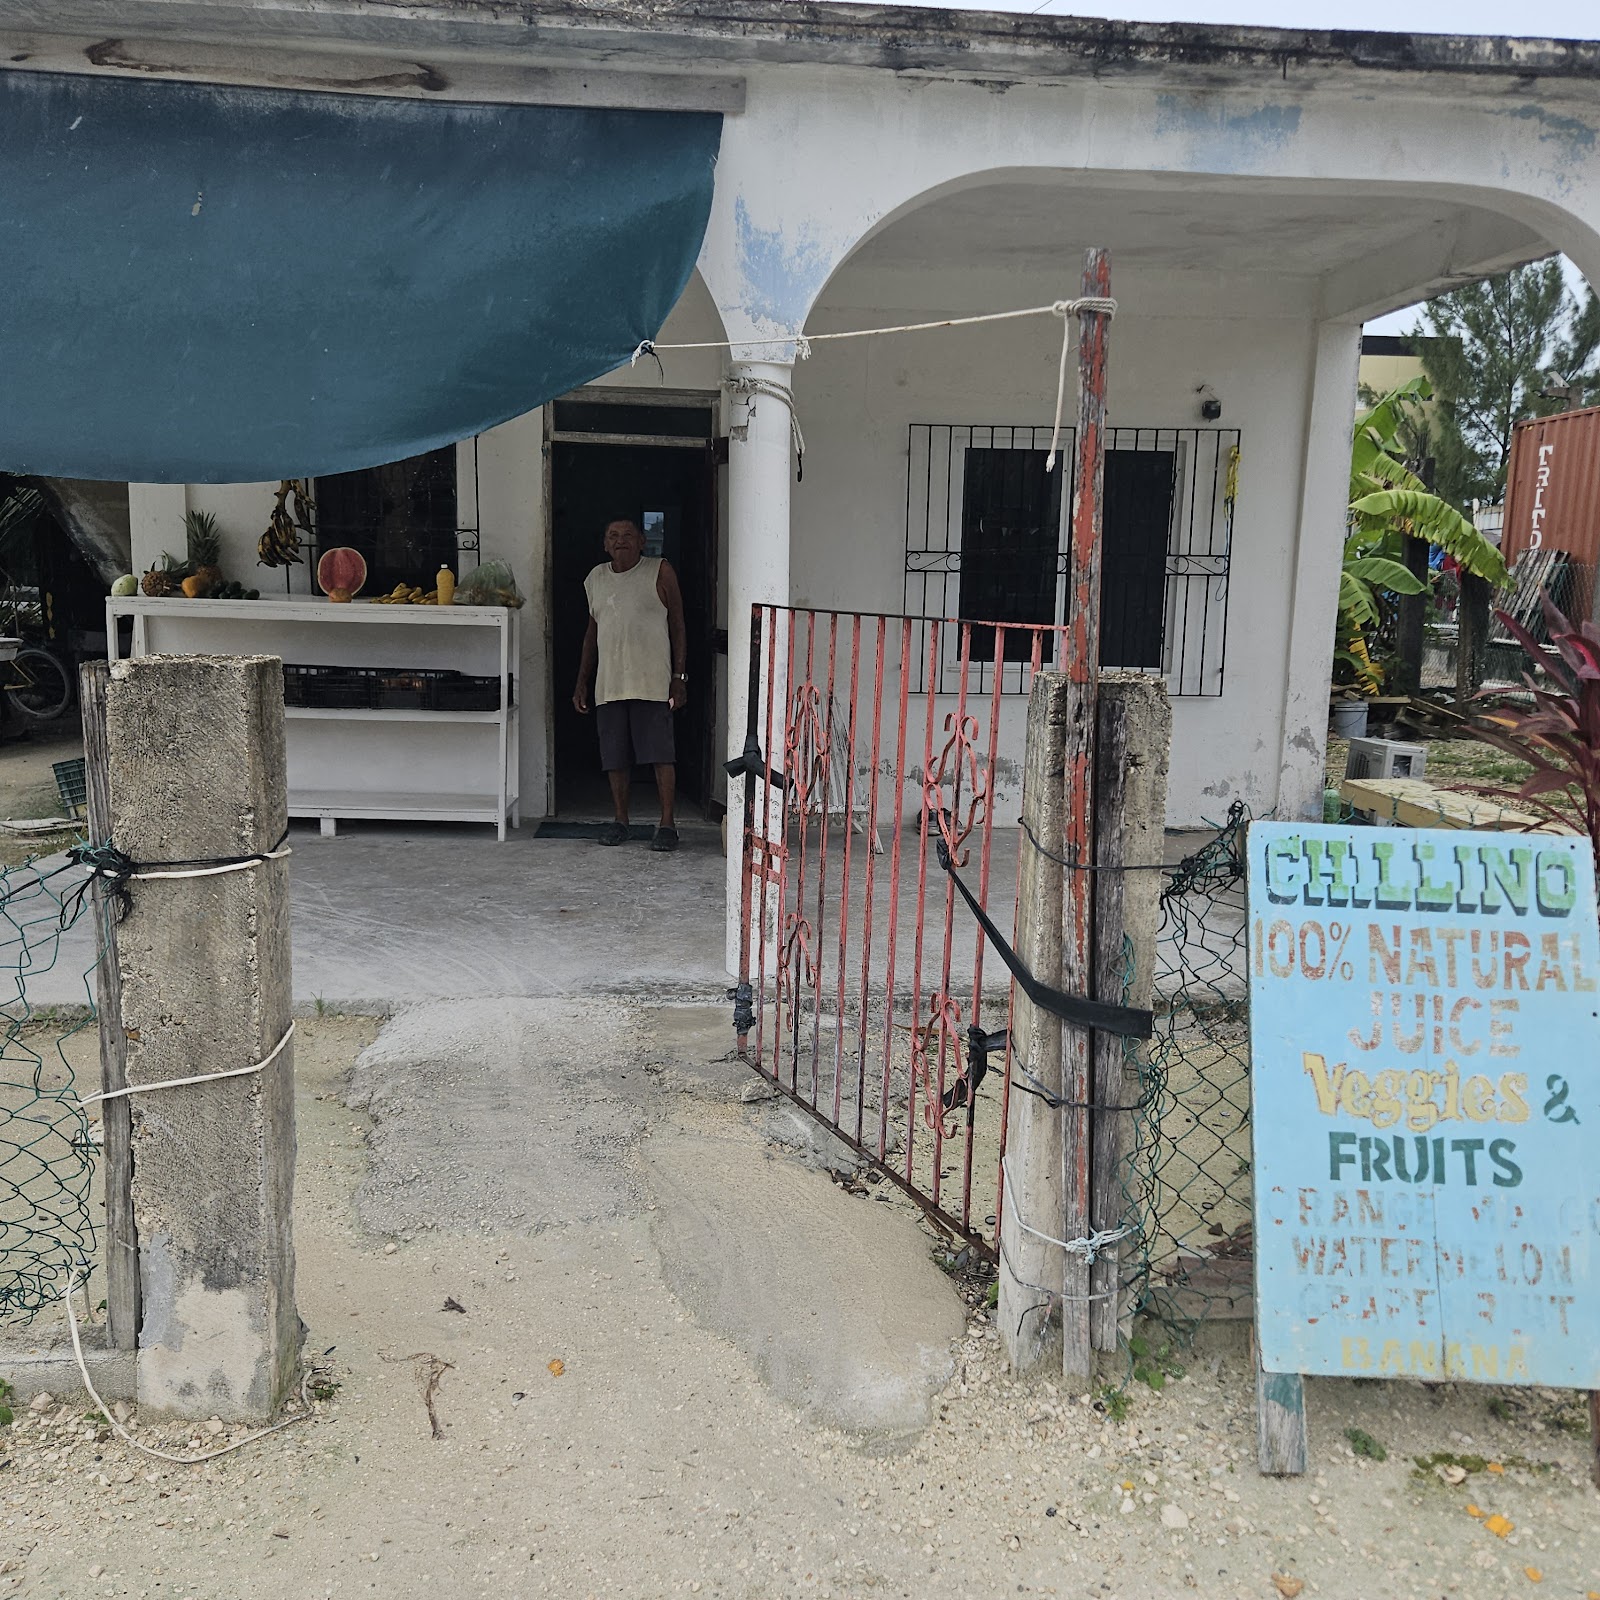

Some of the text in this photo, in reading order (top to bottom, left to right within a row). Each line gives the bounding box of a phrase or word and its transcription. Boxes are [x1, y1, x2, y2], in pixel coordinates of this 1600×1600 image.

[1254, 918, 1598, 992] 100% NATURAL
[1347, 991, 1521, 1057] JUICE
[1303, 1052, 1581, 1133] Veggies &
[1328, 1131, 1524, 1187] FRUITS
[1300, 1282, 1576, 1335] GRAPERT
[1341, 1336, 1530, 1379] BANANA
